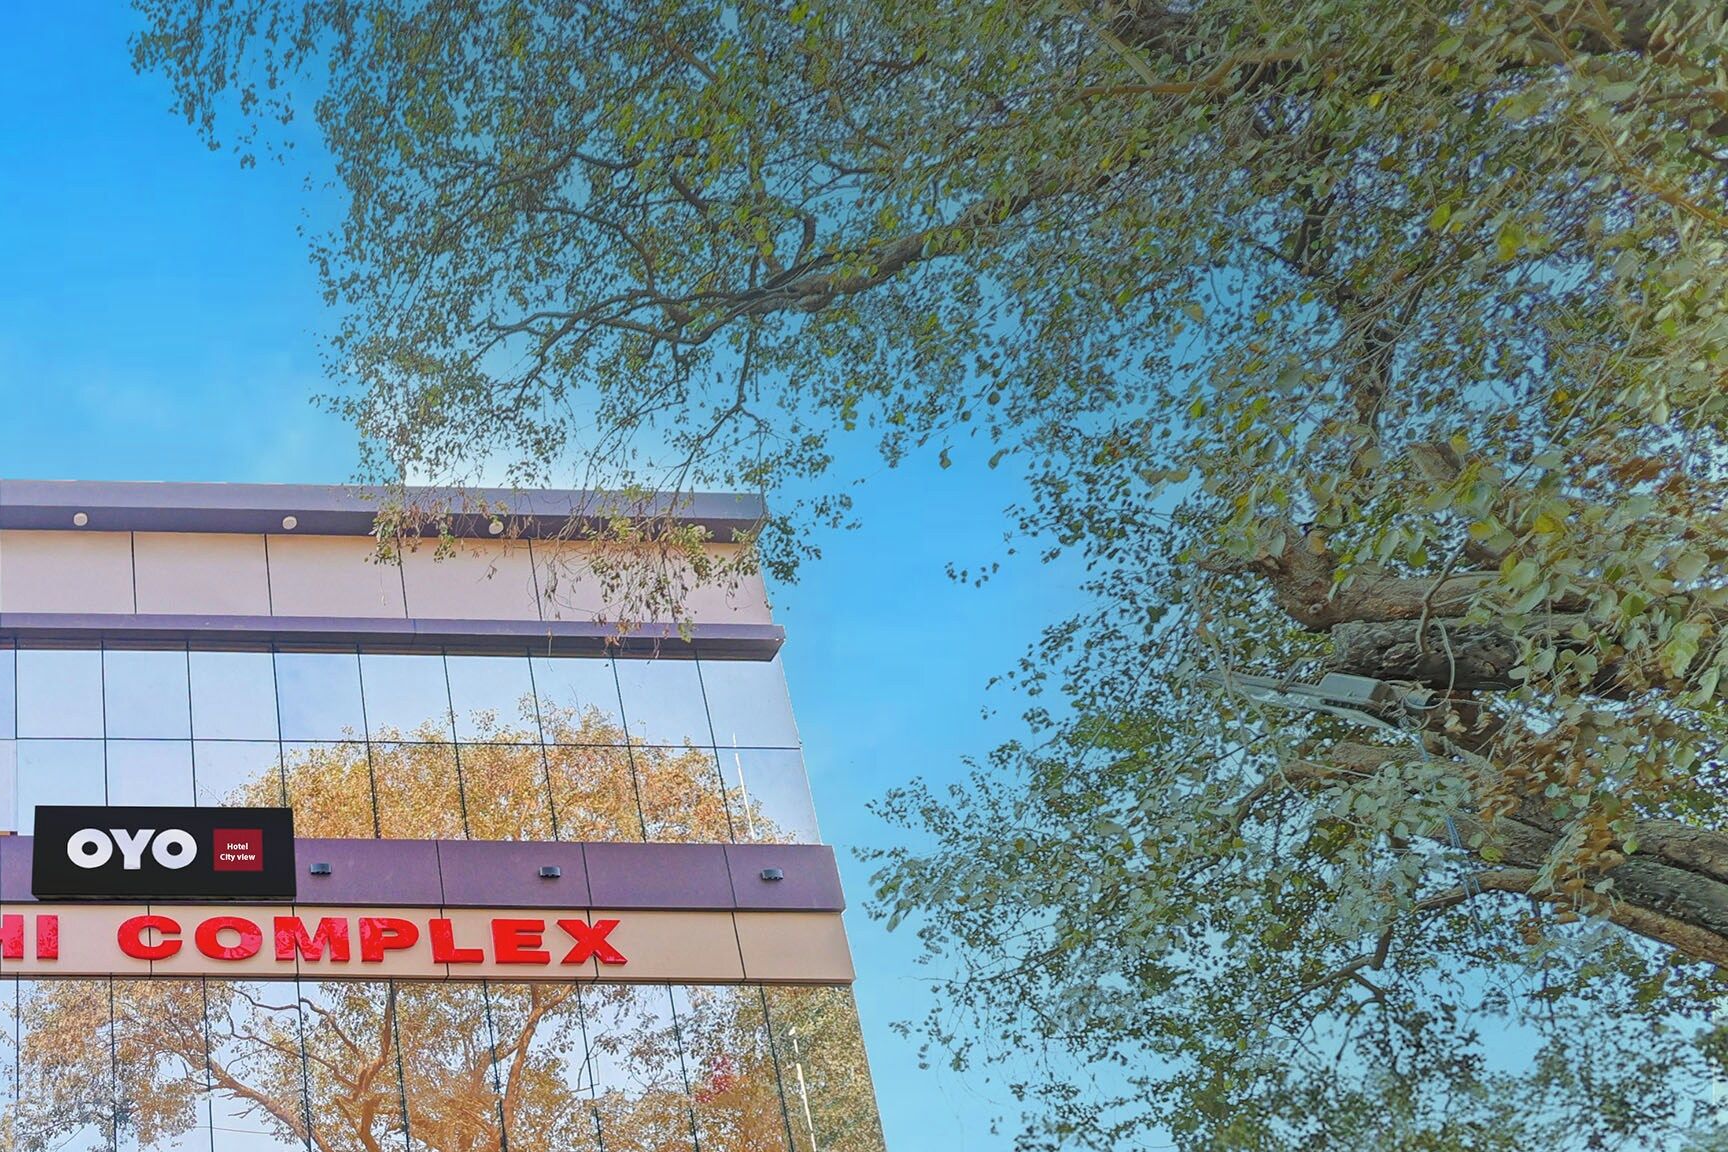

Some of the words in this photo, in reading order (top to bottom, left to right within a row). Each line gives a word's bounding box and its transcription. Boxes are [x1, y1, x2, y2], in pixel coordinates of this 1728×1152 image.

[67, 828, 197, 869] OYO
[220, 853, 238, 862] City
[117, 915, 629, 966] COMPLEX
